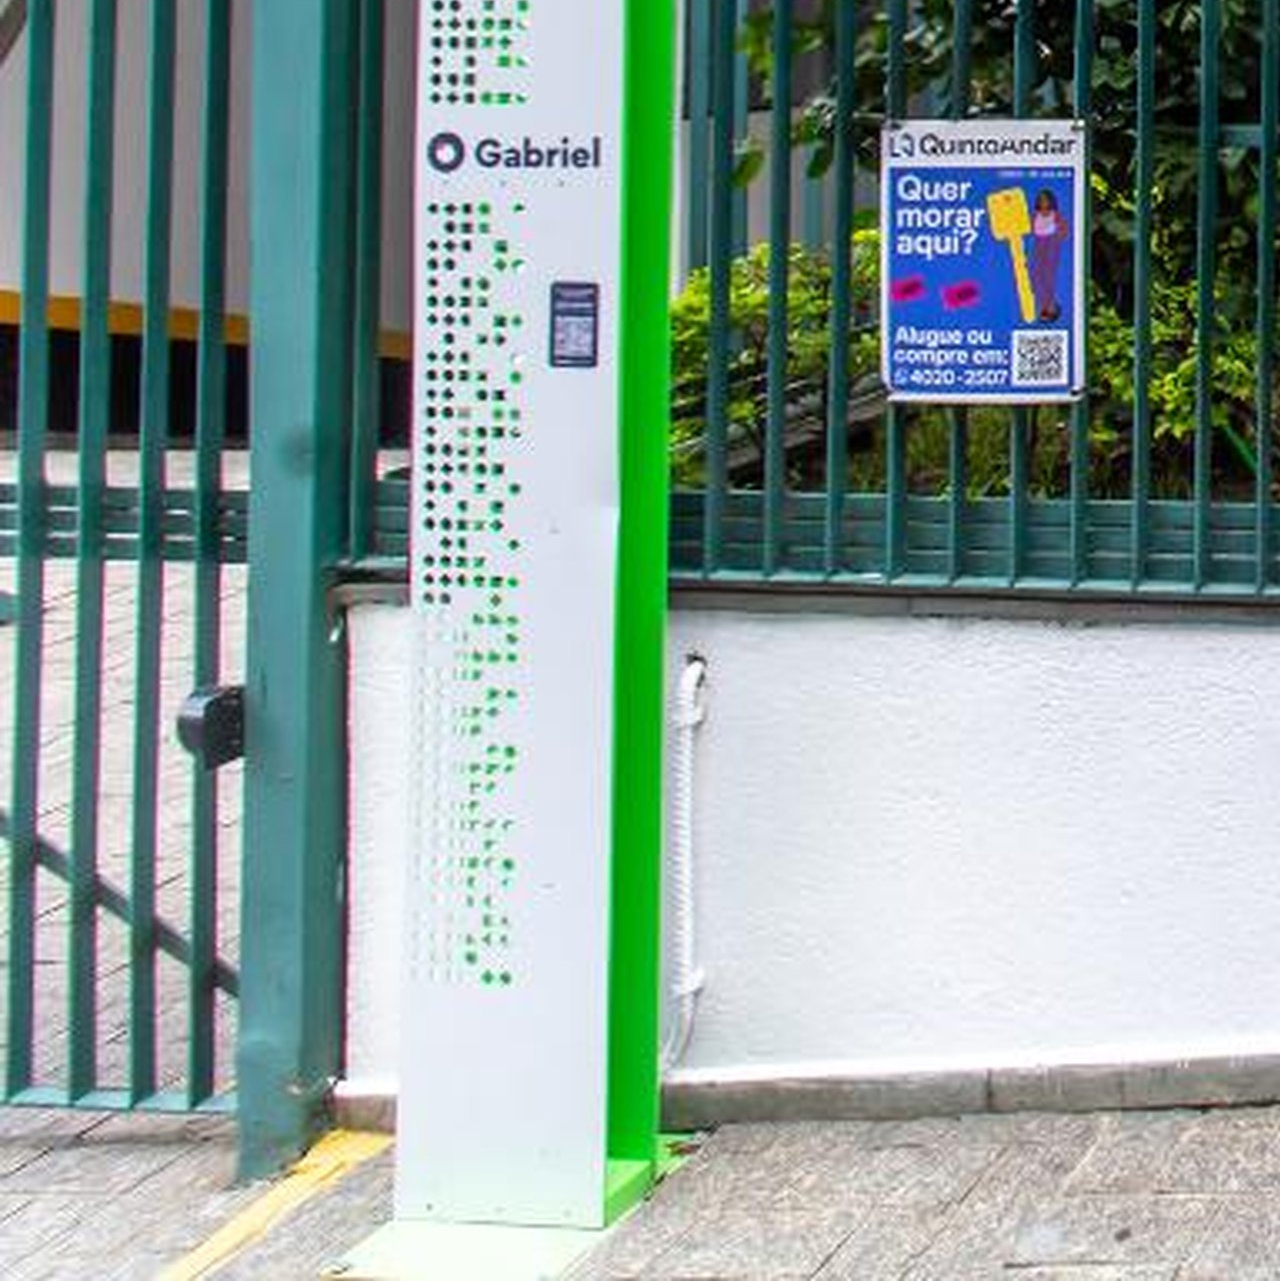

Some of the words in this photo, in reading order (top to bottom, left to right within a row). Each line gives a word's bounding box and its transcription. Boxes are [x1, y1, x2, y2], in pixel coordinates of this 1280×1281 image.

[474, 136, 601, 169] Gabriel
[918, 133, 1076, 157] QuintoAndar
[896, 175, 972, 202] Quer
[896, 208, 985, 229] morar
[896, 230, 978, 260] aqui?
[894, 325, 964, 347] Alugue
[966, 329, 993, 346] ou
[893, 349, 969, 368] compre
[972, 348, 1009, 365] em:
